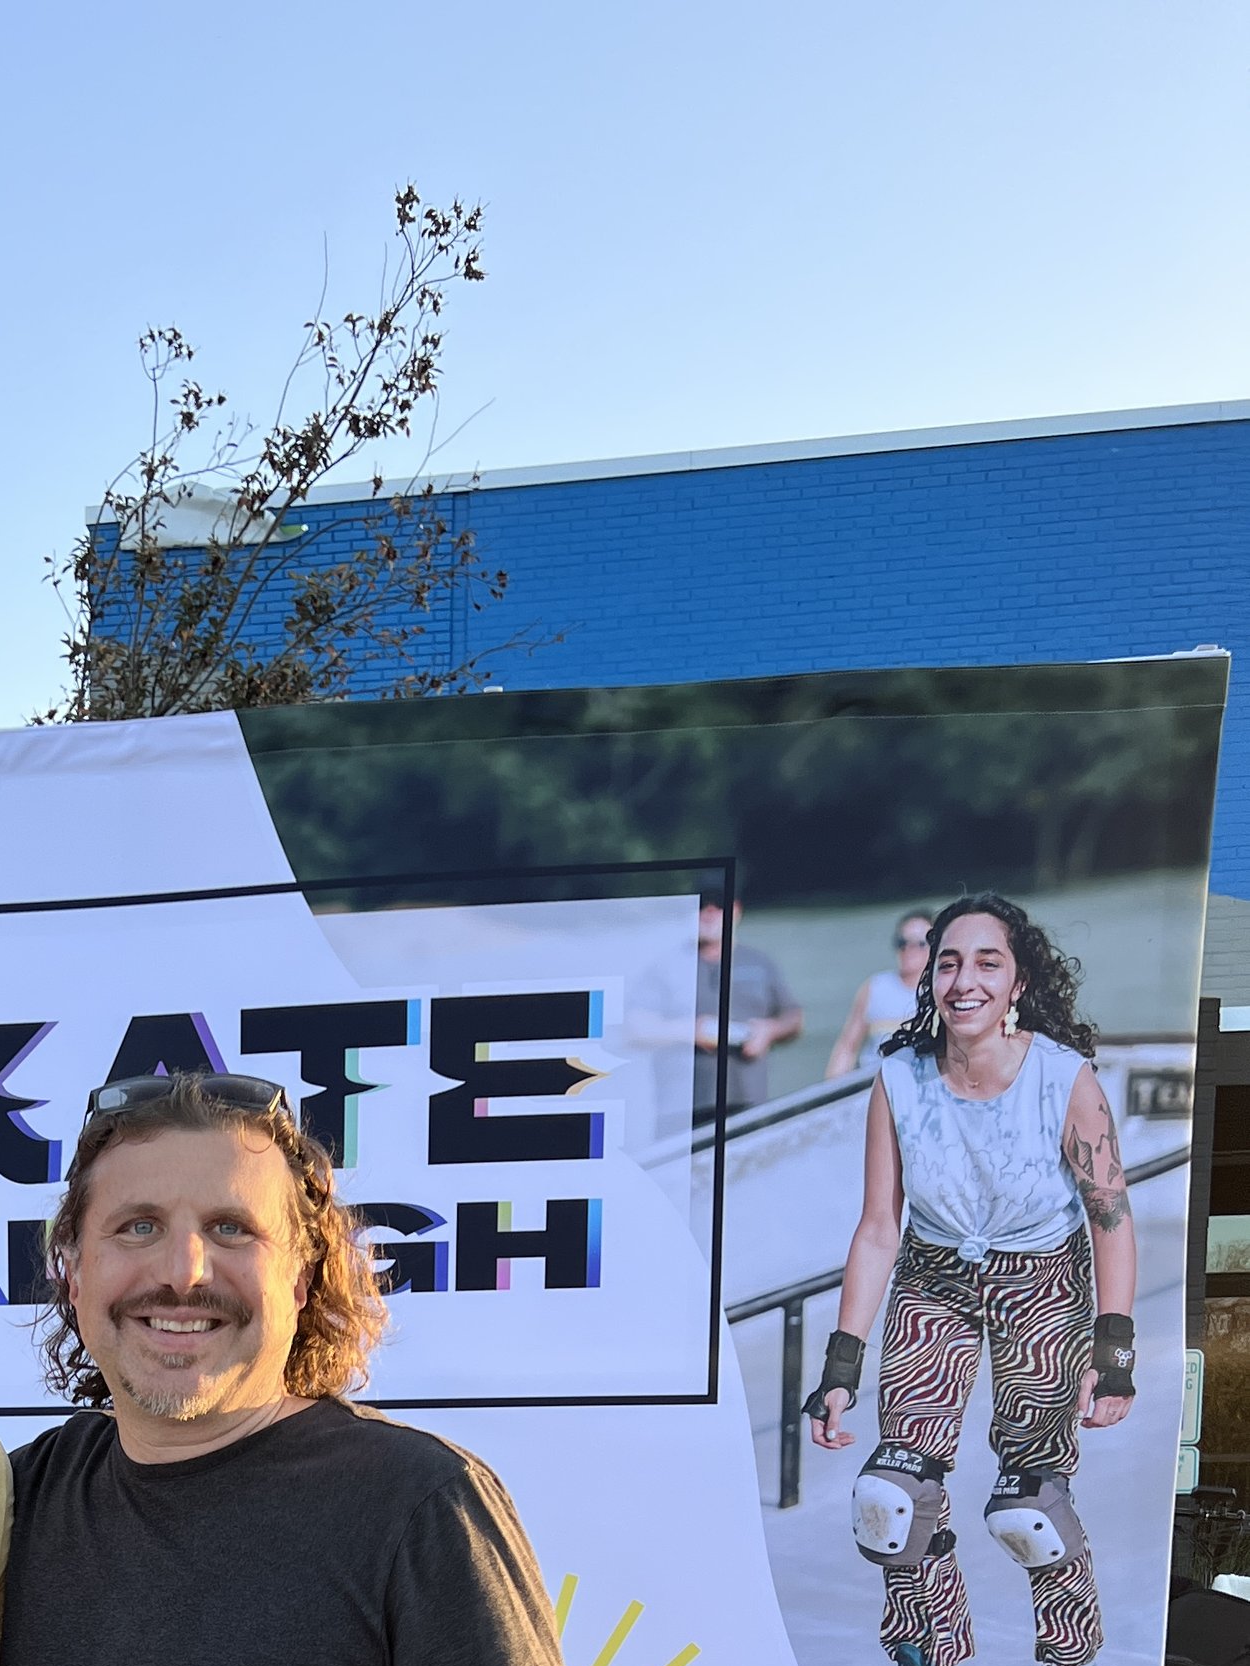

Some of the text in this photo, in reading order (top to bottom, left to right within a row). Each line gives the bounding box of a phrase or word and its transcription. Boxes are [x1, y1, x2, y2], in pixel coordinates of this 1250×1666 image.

[882, 1448, 924, 1464] 187
[875, 1457, 922, 1474] KILLER PADS
